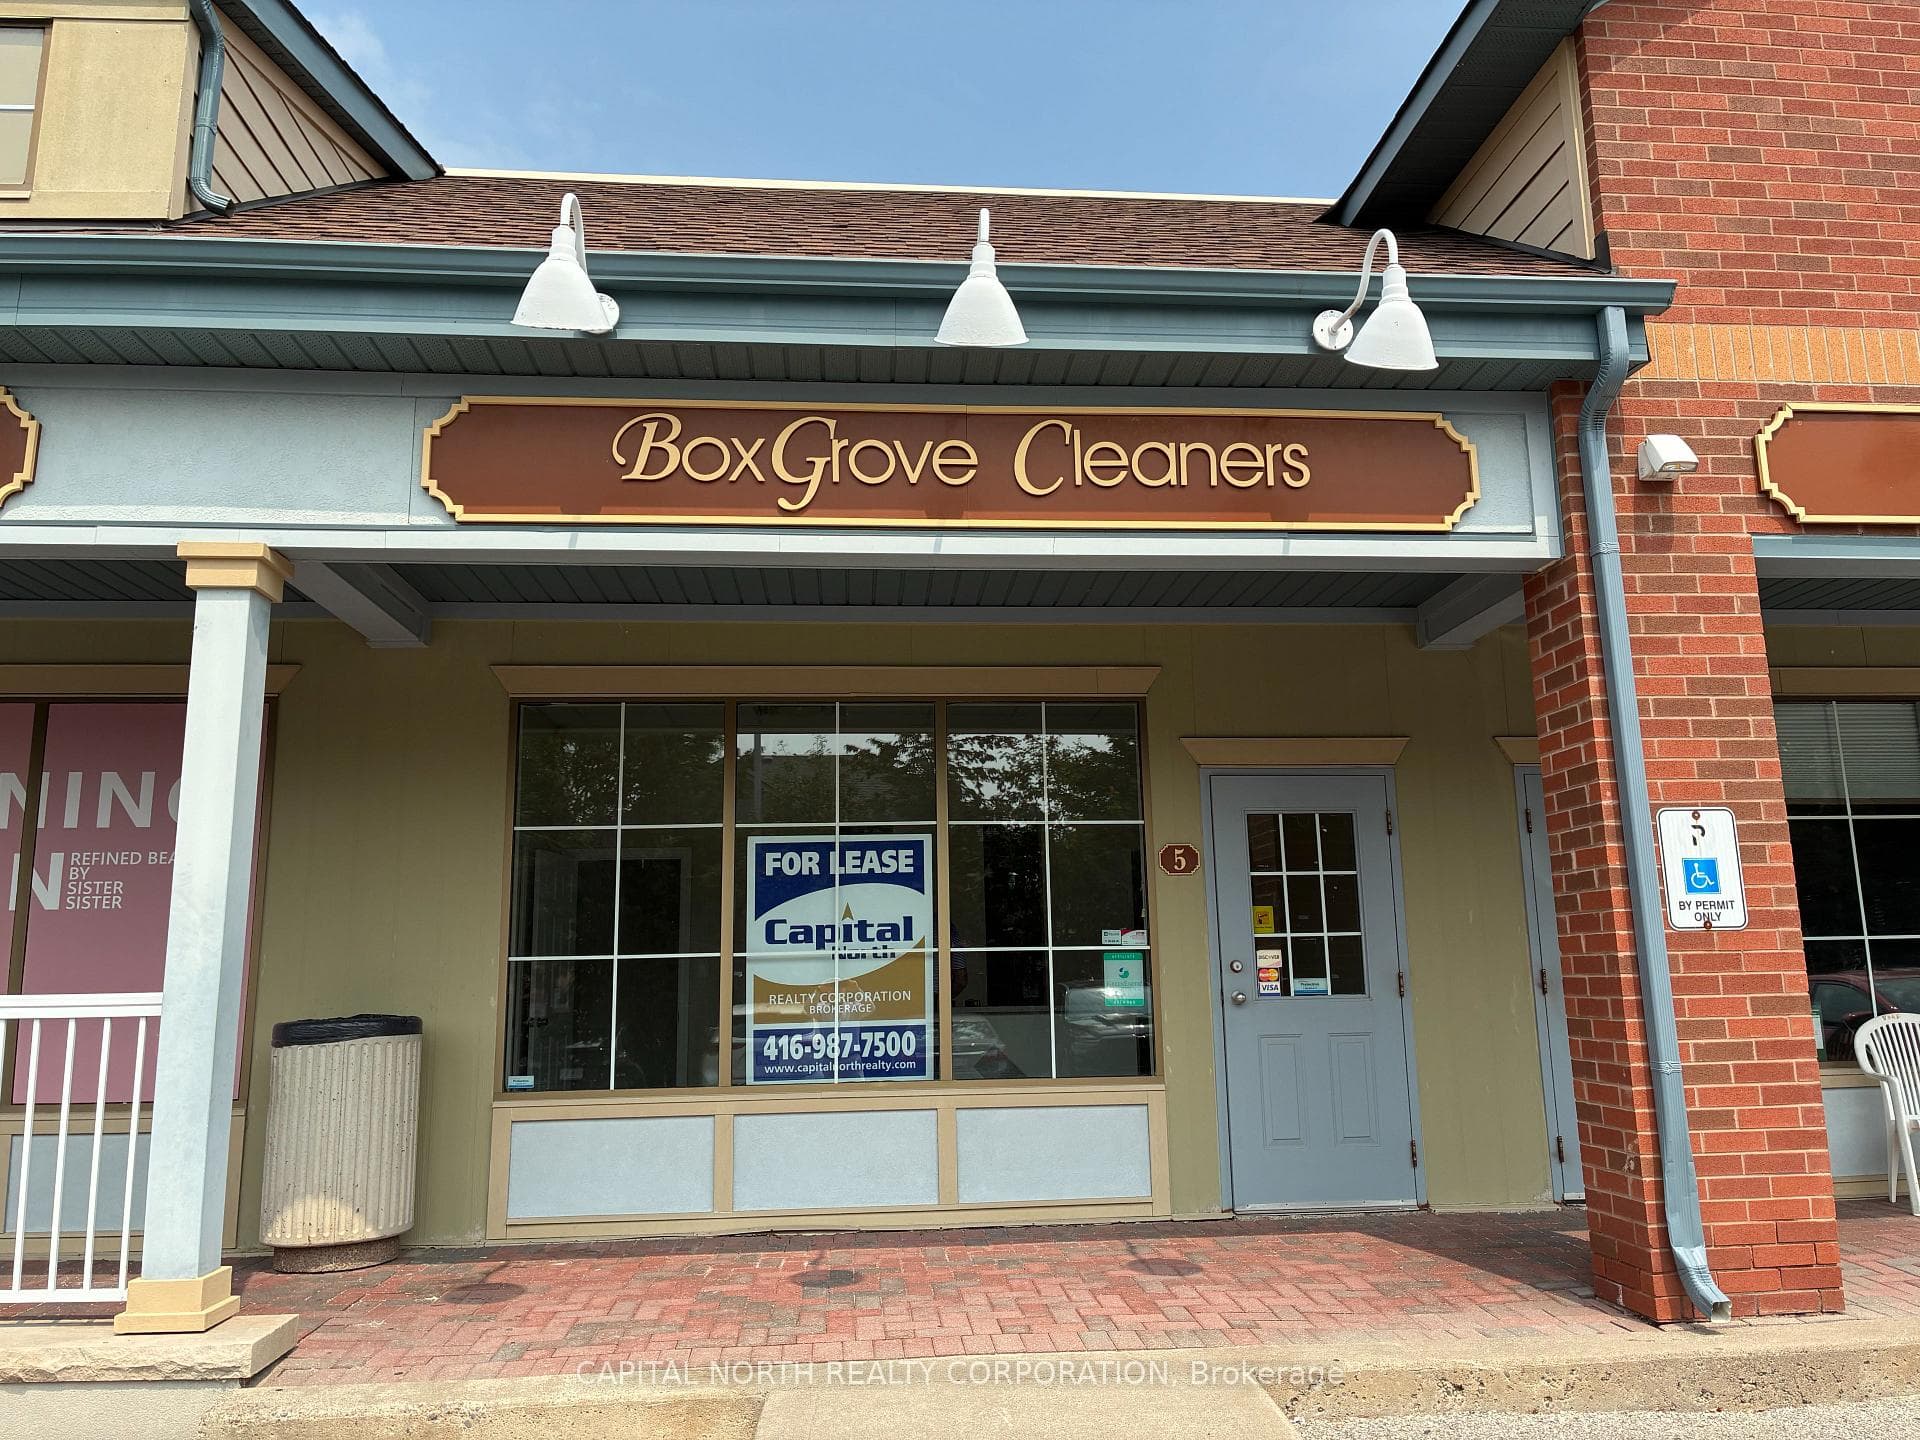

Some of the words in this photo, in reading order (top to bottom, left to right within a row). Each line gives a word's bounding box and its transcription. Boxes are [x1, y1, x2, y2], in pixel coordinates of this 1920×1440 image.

[1013, 418, 1311, 496] Cleaners
[0, 771, 181, 829] NIN
[71, 852, 142, 866] REFINED
[765, 851, 820, 876] FOR
[829, 850, 914, 875] LEASE
[1174, 848, 1187, 871] 5
[69, 867, 90, 880] BY
[67, 881, 124, 895] SISTER
[65, 896, 122, 910] SISTER
[1679, 900, 1692, 910] BY
[1696, 900, 1735, 910] PERMIT
[1695, 912, 1722, 922] ONLY
[765, 916, 914, 950] Capital
[769, 993, 816, 1005] REALTY
[819, 990, 912, 1004] CORPORATION
[763, 1031, 916, 1061] 416-987-7500
[764, 1060, 916, 1075] www.capitalorthrealty.com
